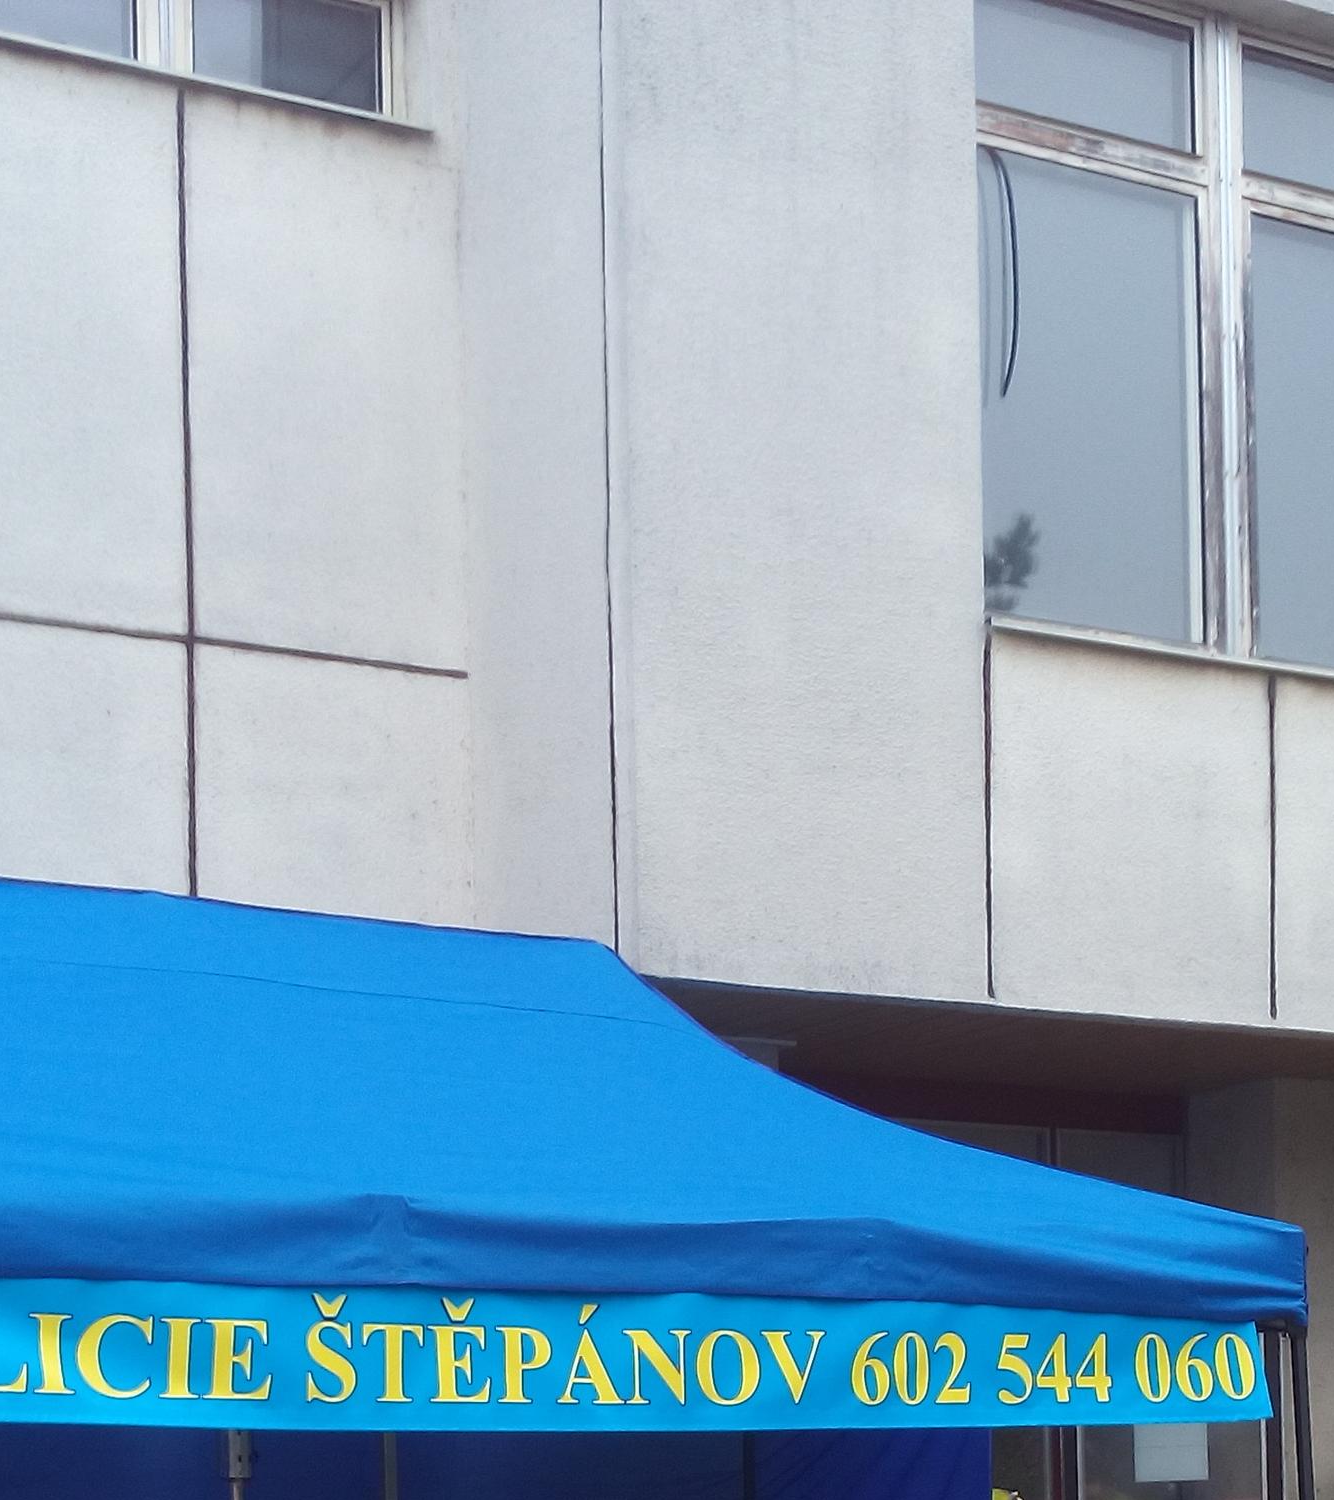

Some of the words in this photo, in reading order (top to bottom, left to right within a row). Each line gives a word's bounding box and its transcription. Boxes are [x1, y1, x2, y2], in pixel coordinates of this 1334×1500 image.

[305, 1292, 826, 1406] ŠTĚPÁNOV
[851, 1331, 971, 1405] 602
[997, 1333, 1112, 1403] 544
[1134, 1332, 1256, 1402] 060
